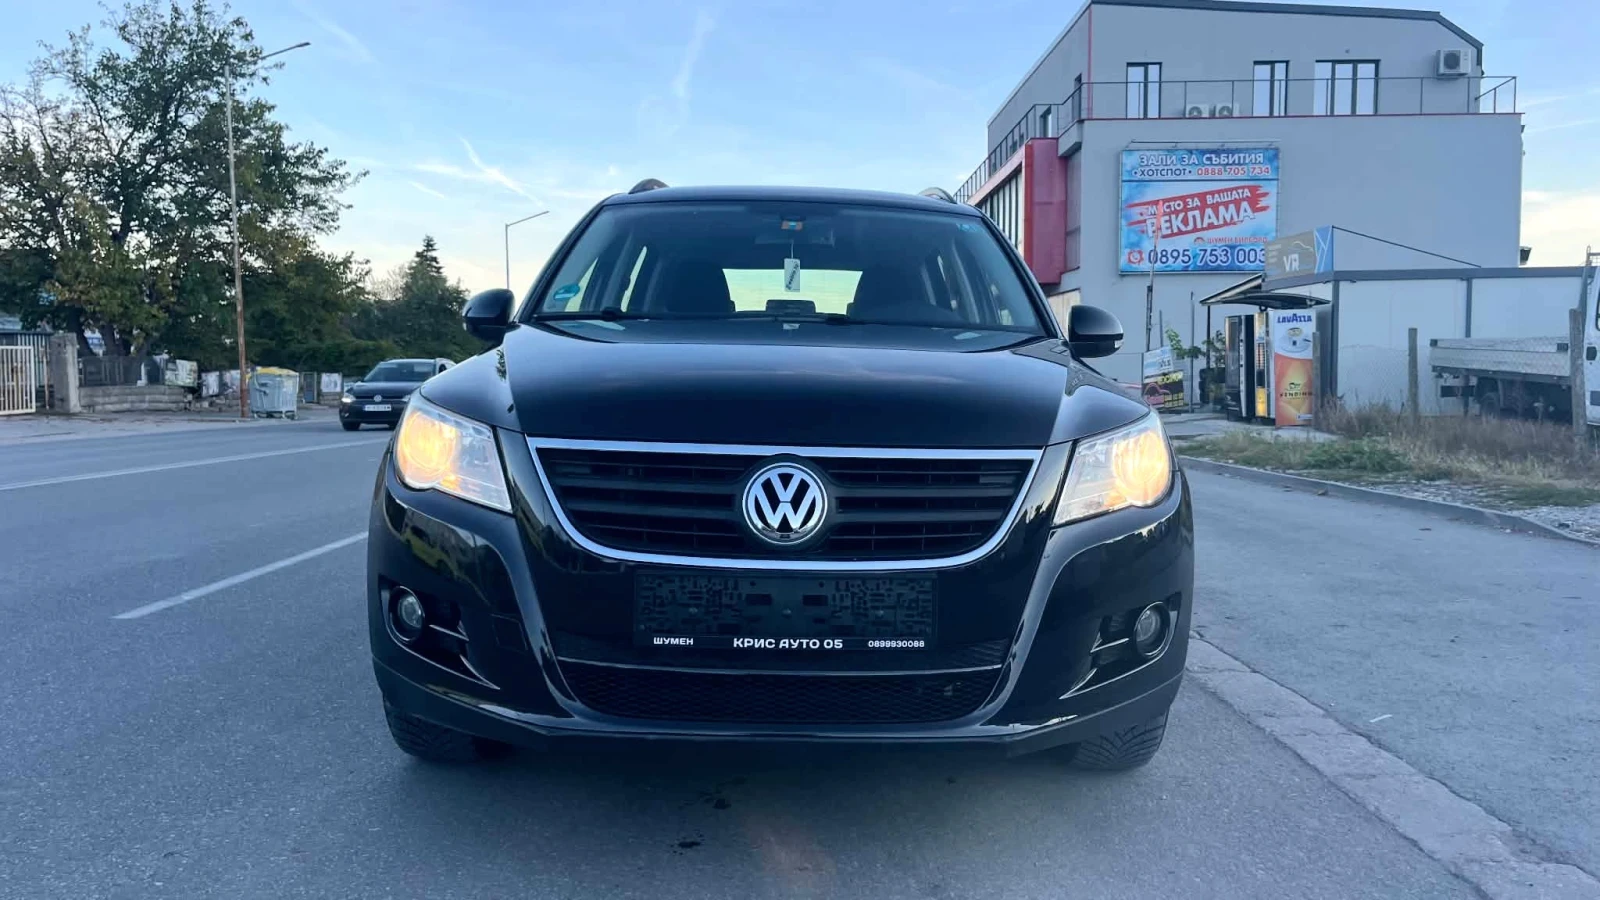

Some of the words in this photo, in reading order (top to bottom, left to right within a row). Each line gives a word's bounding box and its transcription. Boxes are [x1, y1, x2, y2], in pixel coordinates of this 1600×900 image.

[1139, 154, 1177, 166] ЗАЛИ
[1180, 154, 1199, 165] ЗА
[1202, 152, 1264, 165] СЪБИТИЯ
[1197, 167, 1223, 176] 0888
[1227, 166, 1246, 176] 705
[1250, 166, 1270, 175] 734
[1148, 200, 1184, 216] МСТО
[1185, 197, 1201, 208] ЗА
[1205, 188, 1251, 205] ВАШАТА
[1148, 248, 1191, 265] 0895
[1198, 248, 1231, 264] 753
[1283, 253, 1300, 272] VR
[653, 637, 694, 646] ШУМЕН
[733, 638, 776, 649] КРИС
[779, 638, 820, 649] АУТО
